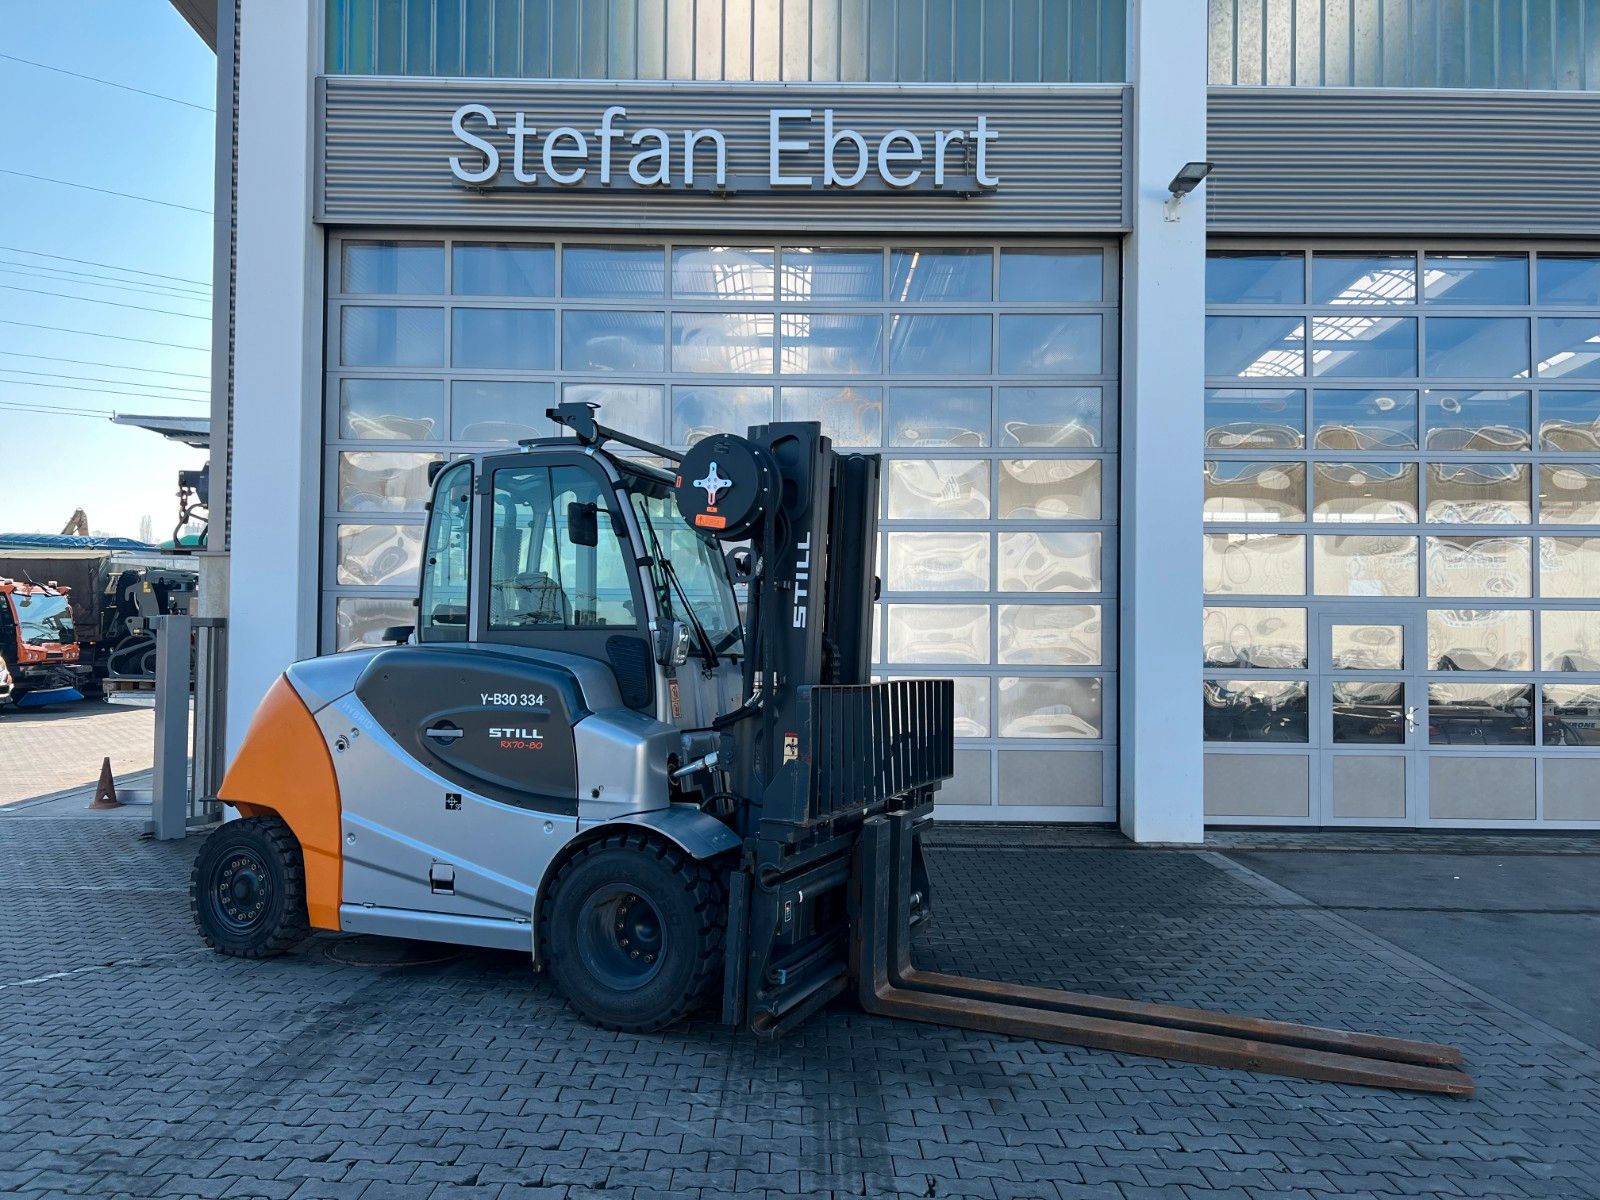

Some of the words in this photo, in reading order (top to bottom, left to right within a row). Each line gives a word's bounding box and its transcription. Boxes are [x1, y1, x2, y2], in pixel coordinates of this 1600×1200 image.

[449, 104, 727, 189] Stefan
[769, 108, 999, 189] Ebert
[792, 531, 811, 629] STILL
[480, 693, 518, 706] Y-B30
[520, 693, 545, 706] 334
[489, 727, 544, 739] STILL
